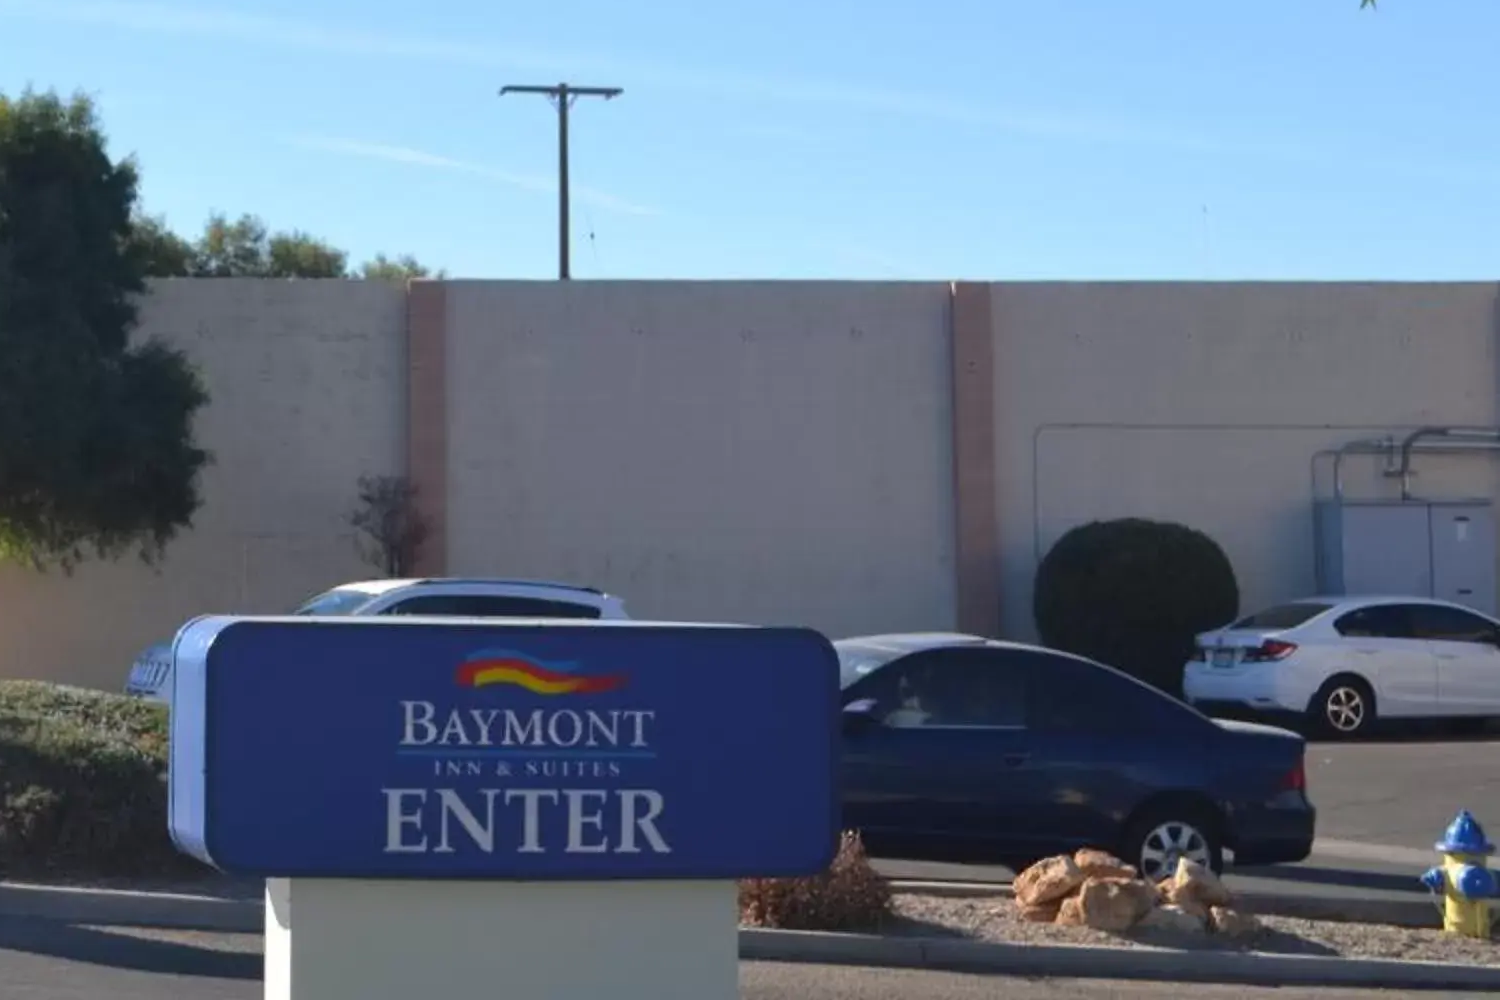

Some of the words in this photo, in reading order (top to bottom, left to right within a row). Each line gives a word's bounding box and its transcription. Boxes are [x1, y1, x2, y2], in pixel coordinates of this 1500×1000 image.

[399, 700, 655, 747] BAYMONT
[434, 760, 483, 777] INN
[496, 760, 512, 777] &
[526, 760, 622, 777] SUITES
[381, 788, 671, 854] ENTER
